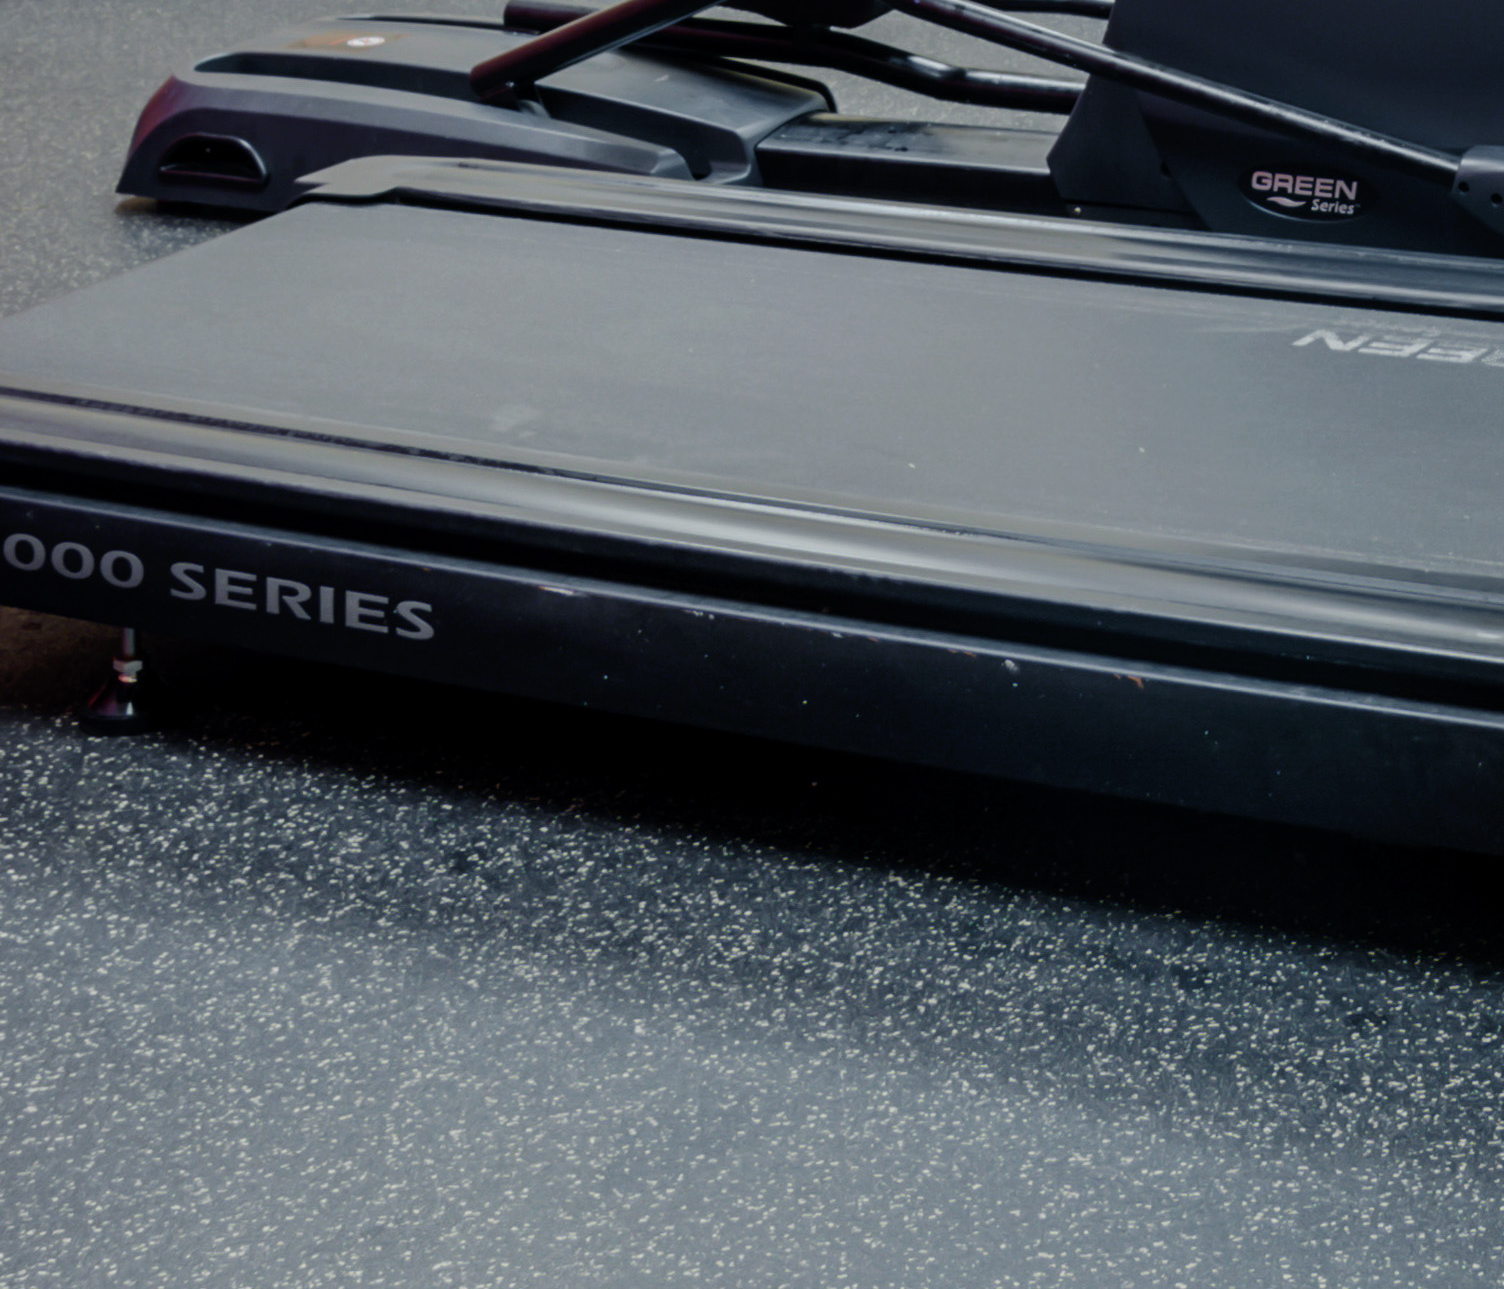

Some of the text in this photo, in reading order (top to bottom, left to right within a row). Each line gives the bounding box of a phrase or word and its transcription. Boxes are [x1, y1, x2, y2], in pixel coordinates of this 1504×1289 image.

[1251, 170, 1358, 201] GREEN
[1311, 198, 1355, 215] Series
[169, 562, 435, 640] SERIES
